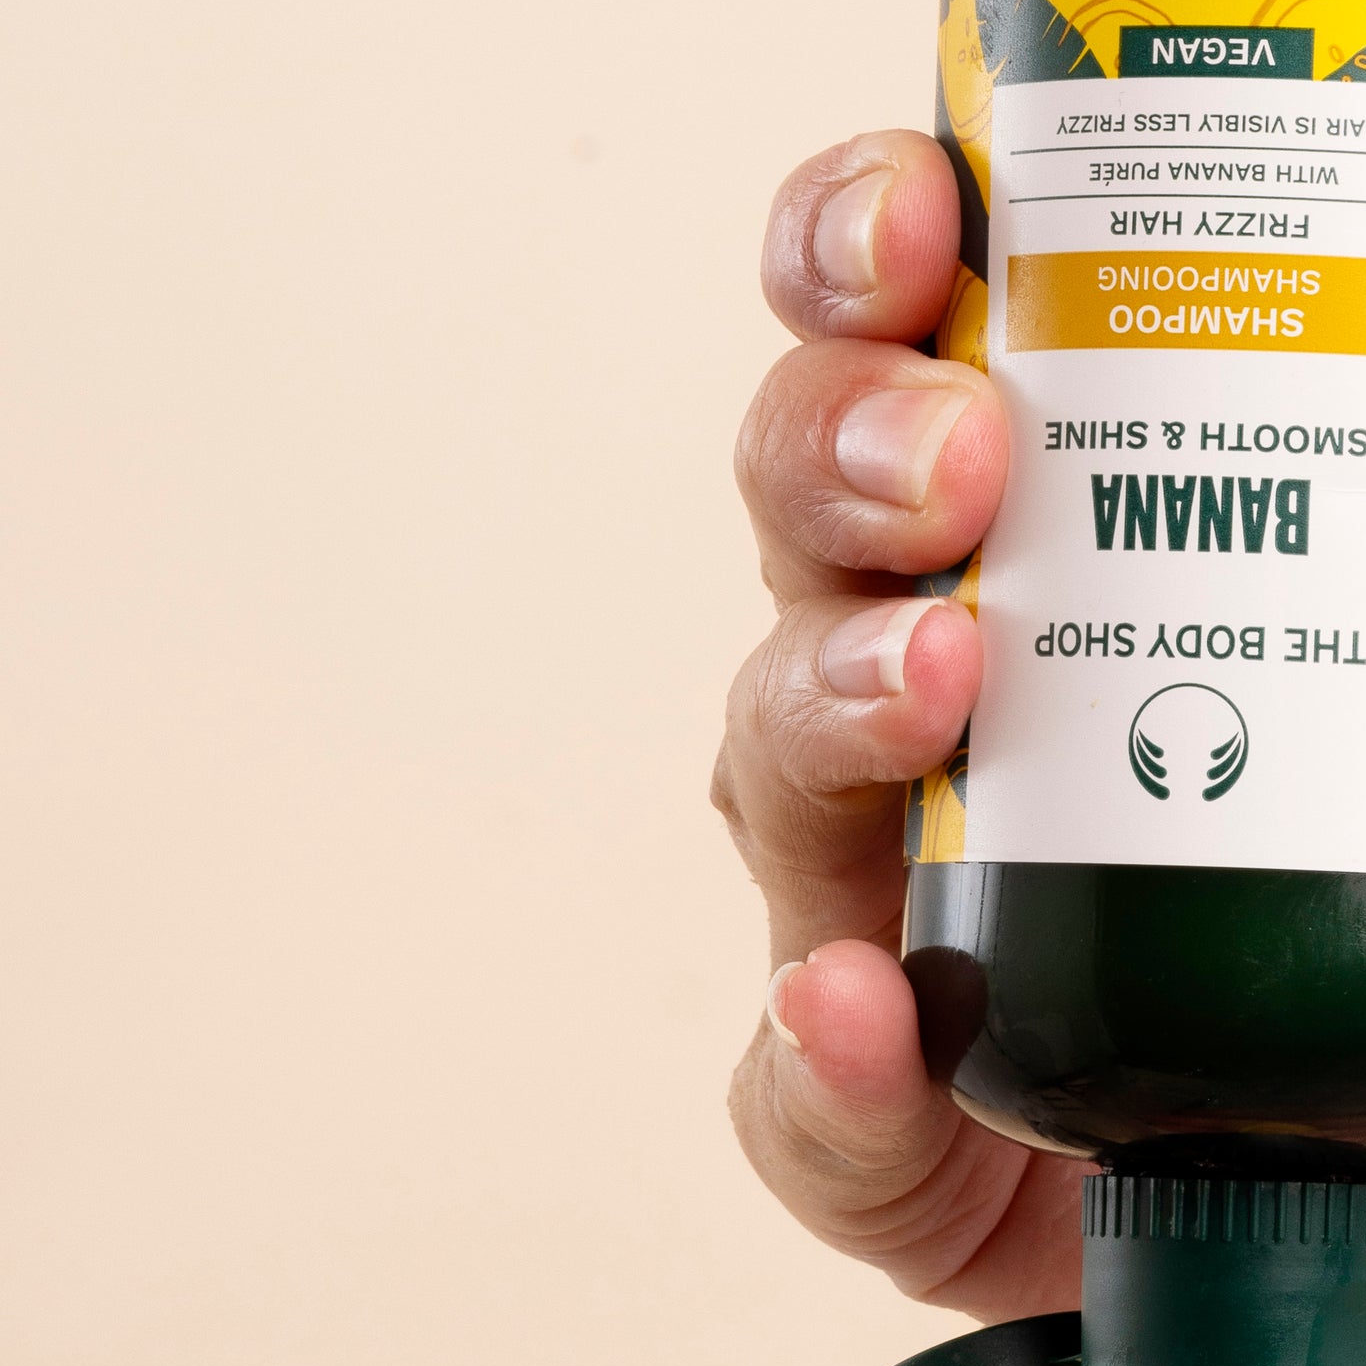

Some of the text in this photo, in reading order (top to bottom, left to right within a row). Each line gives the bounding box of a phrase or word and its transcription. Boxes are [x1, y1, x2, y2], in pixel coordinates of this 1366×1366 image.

[1152, 37, 1276, 66] VEGAN
[1056, 113, 1126, 135] FRIZZY
[1133, 113, 1191, 132] LESS
[1198, 113, 1287, 134] VISIBLY
[1294, 116, 1316, 136] IS
[1089, 162, 1339, 187] WITH BANANA PURÉE
[1110, 210, 1309, 239] FRIZZY HAIR
[1098, 266, 1321, 296] SHAMPOOING
[1108, 304, 1305, 338] SHAMPOO
[1044, 420, 1149, 451] SHINE
[1160, 421, 1186, 451] &
[1090, 473, 1311, 556] BANANA
[1034, 622, 1137, 658] SHOP
[1146, 623, 1265, 661] BODY
